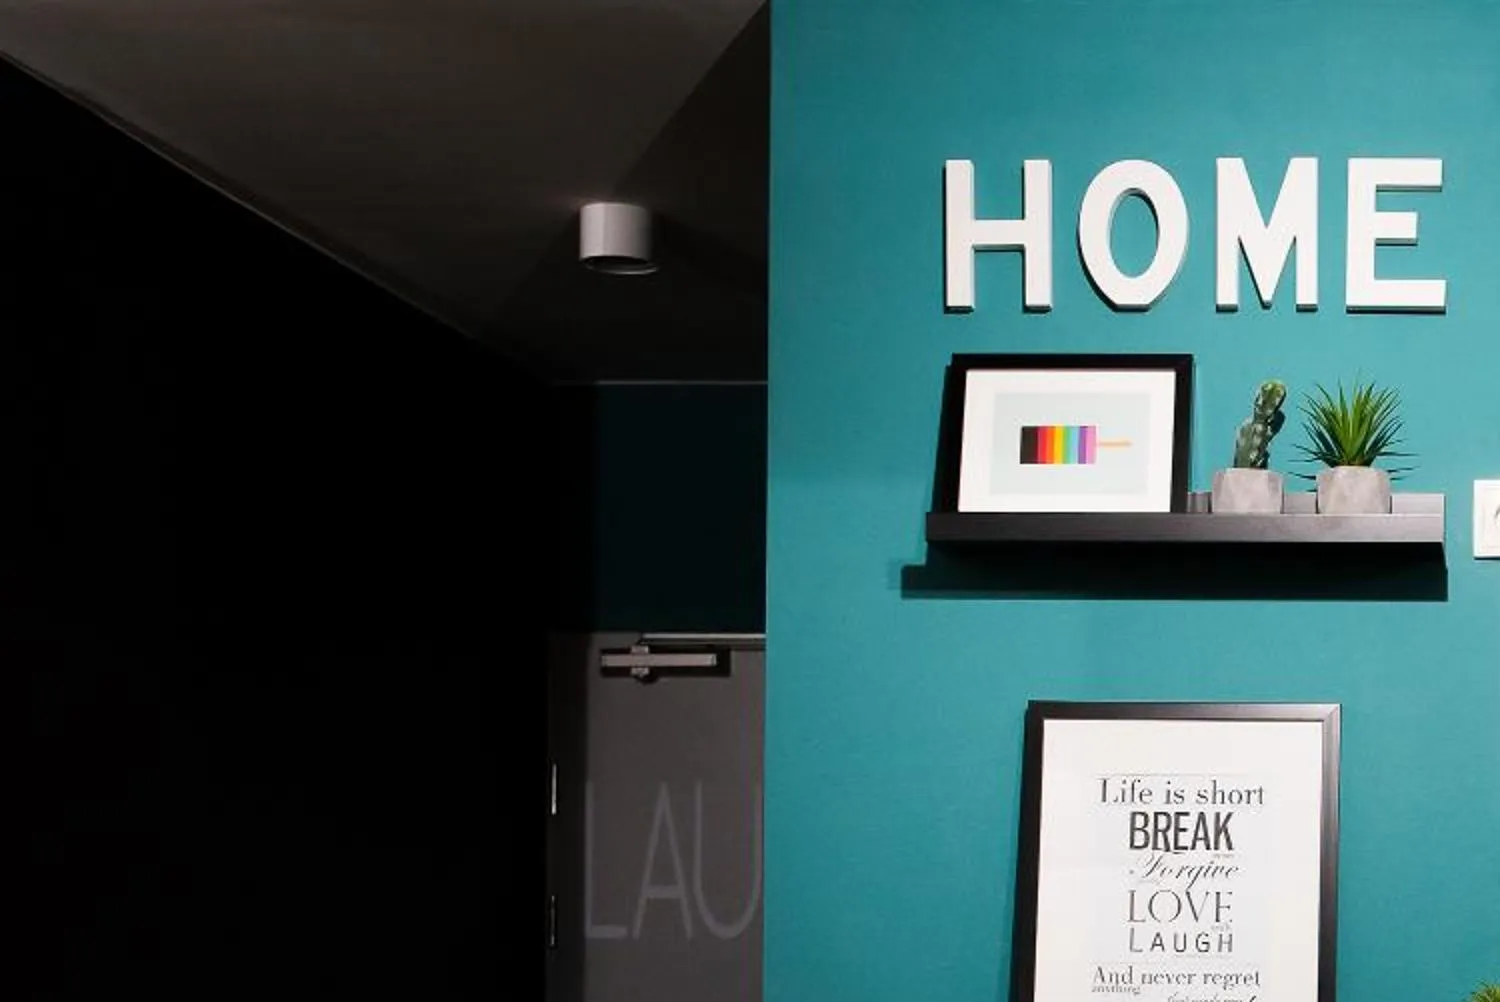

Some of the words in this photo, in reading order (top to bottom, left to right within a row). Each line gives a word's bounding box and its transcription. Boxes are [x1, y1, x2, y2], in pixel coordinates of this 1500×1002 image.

[944, 156, 1447, 313] HOME
[1101, 777, 1153, 805] Life
[1164, 779, 1185, 805] is
[1196, 778, 1265, 805] short
[1128, 810, 1234, 852] BREAK
[1129, 854, 1241, 889] Forgive
[1127, 889, 1233, 923] LOVE
[1128, 927, 1234, 953] LAUGH
[1092, 965, 1134, 985] And
[1141, 971, 1197, 985] never
[1203, 969, 1261, 990] regret
